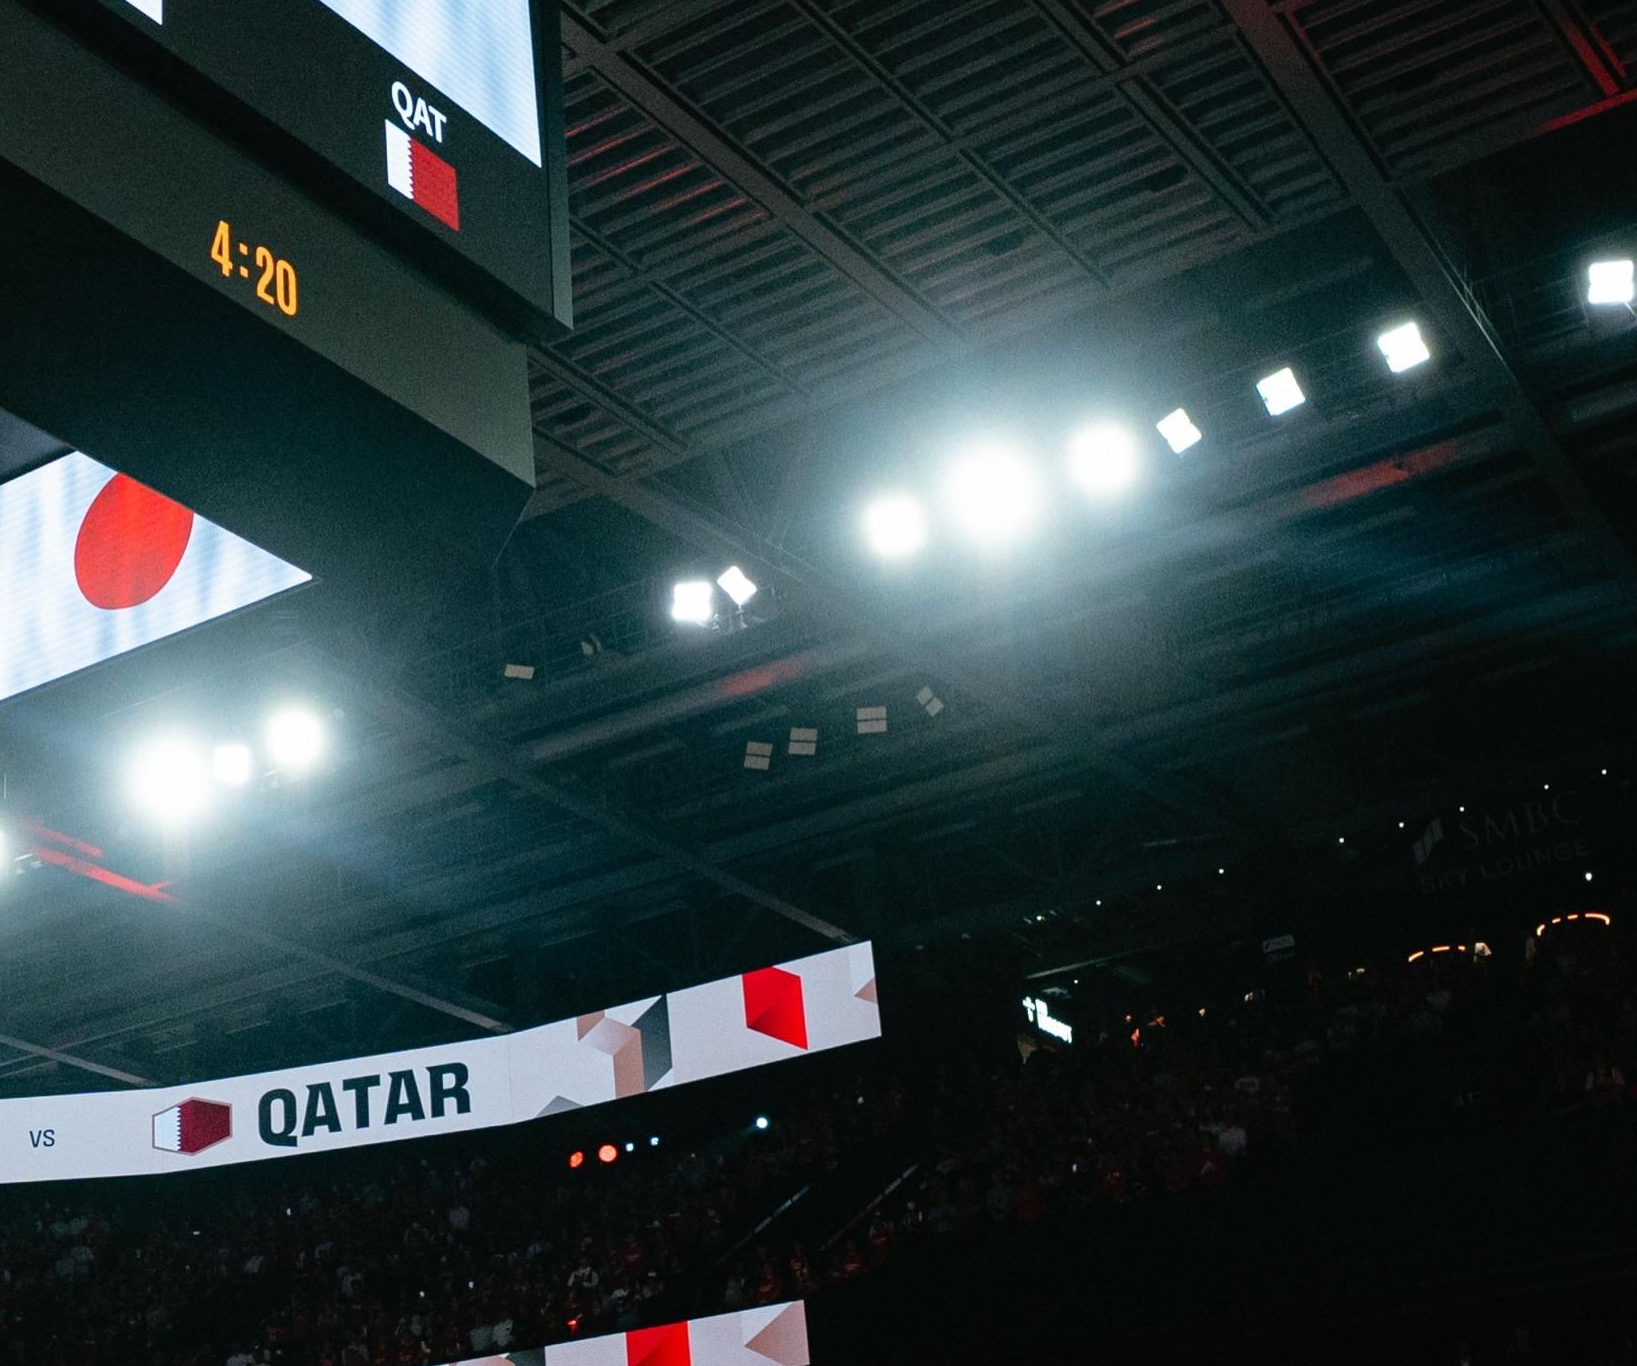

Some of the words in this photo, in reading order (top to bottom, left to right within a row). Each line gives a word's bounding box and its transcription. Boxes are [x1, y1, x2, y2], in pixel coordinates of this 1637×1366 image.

[390, 81, 447, 144] QAT
[210, 219, 298, 316] 4:20
[29, 1129, 55, 1148] VS
[257, 1062, 472, 1148] QATAR
